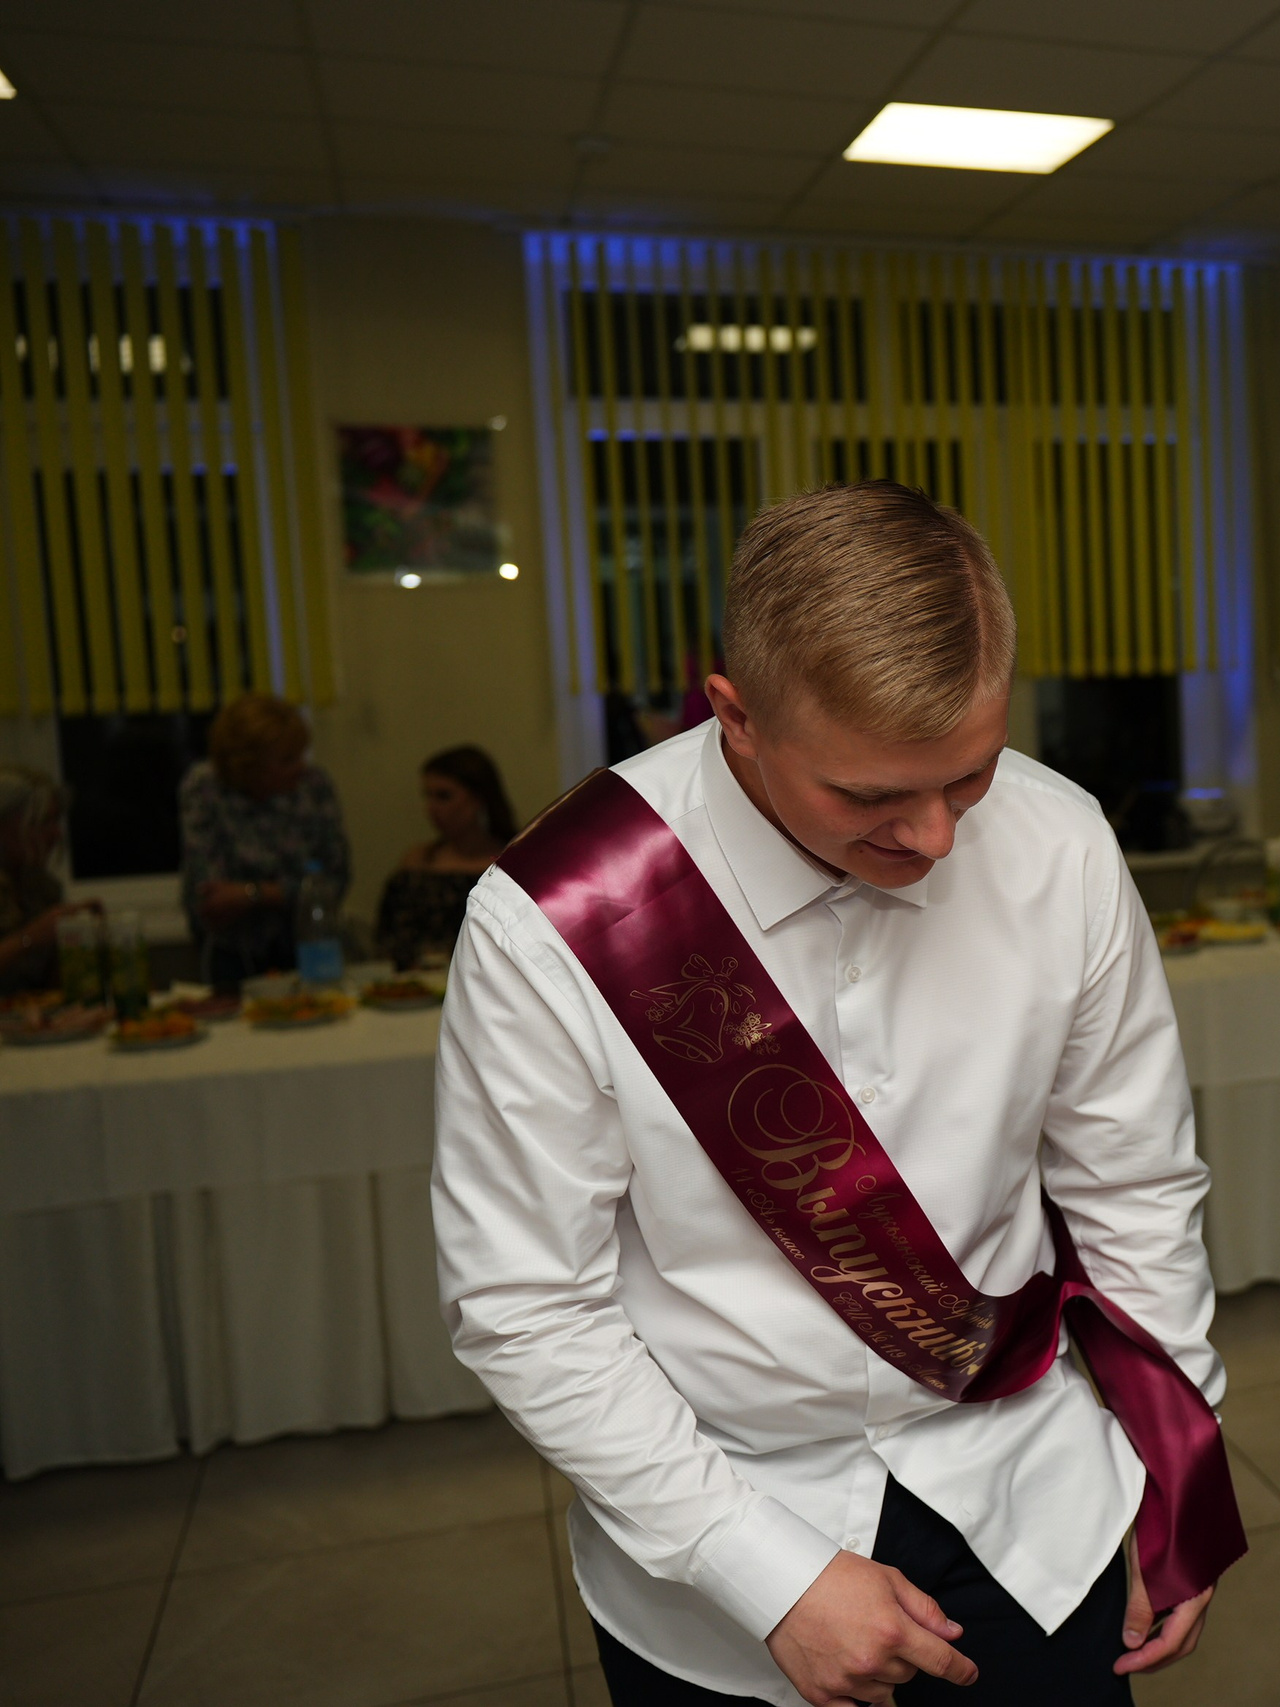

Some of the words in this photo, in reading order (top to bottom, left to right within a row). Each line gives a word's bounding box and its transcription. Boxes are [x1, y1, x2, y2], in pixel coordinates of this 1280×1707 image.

[727, 1063, 988, 1369] Выпускник
[729, 1166, 756, 1184] 11
[771, 1226, 807, 1260] класс
[855, 1174, 945, 1296] Лукьянский
[880, 1342, 908, 1360] 119
